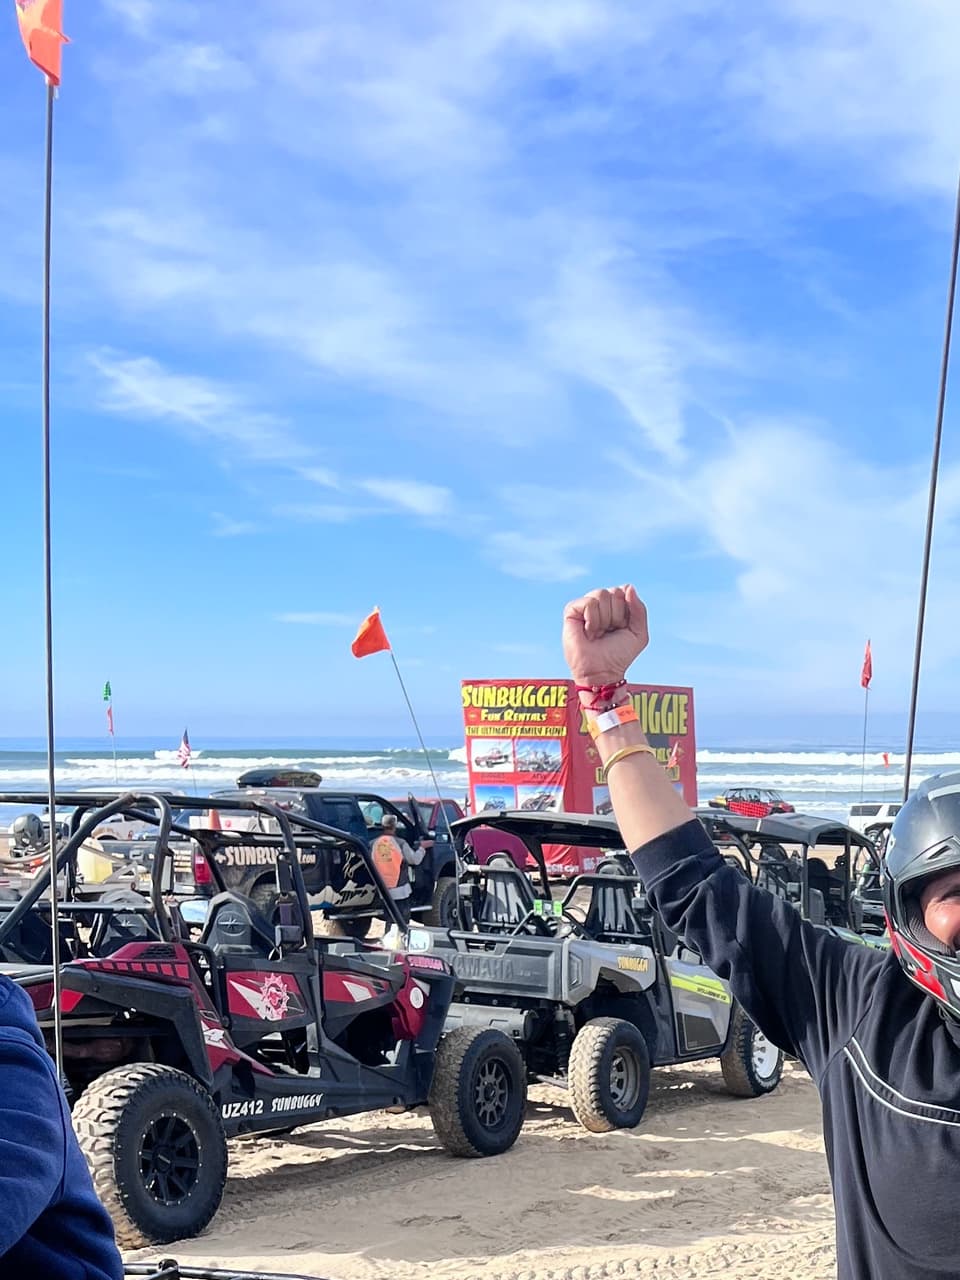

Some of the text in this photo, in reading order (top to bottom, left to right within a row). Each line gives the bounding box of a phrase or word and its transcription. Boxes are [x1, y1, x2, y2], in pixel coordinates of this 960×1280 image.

[461, 684, 569, 708] SUNBUGGIE
[480, 708, 548, 722] FUN RENTALS
[466, 726, 479, 735] THE
[481, 726, 514, 736] ULTIMATE
[515, 726, 544, 736] FAMILY
[221, 1093, 324, 1119] UZ412 SUNBUGGY
